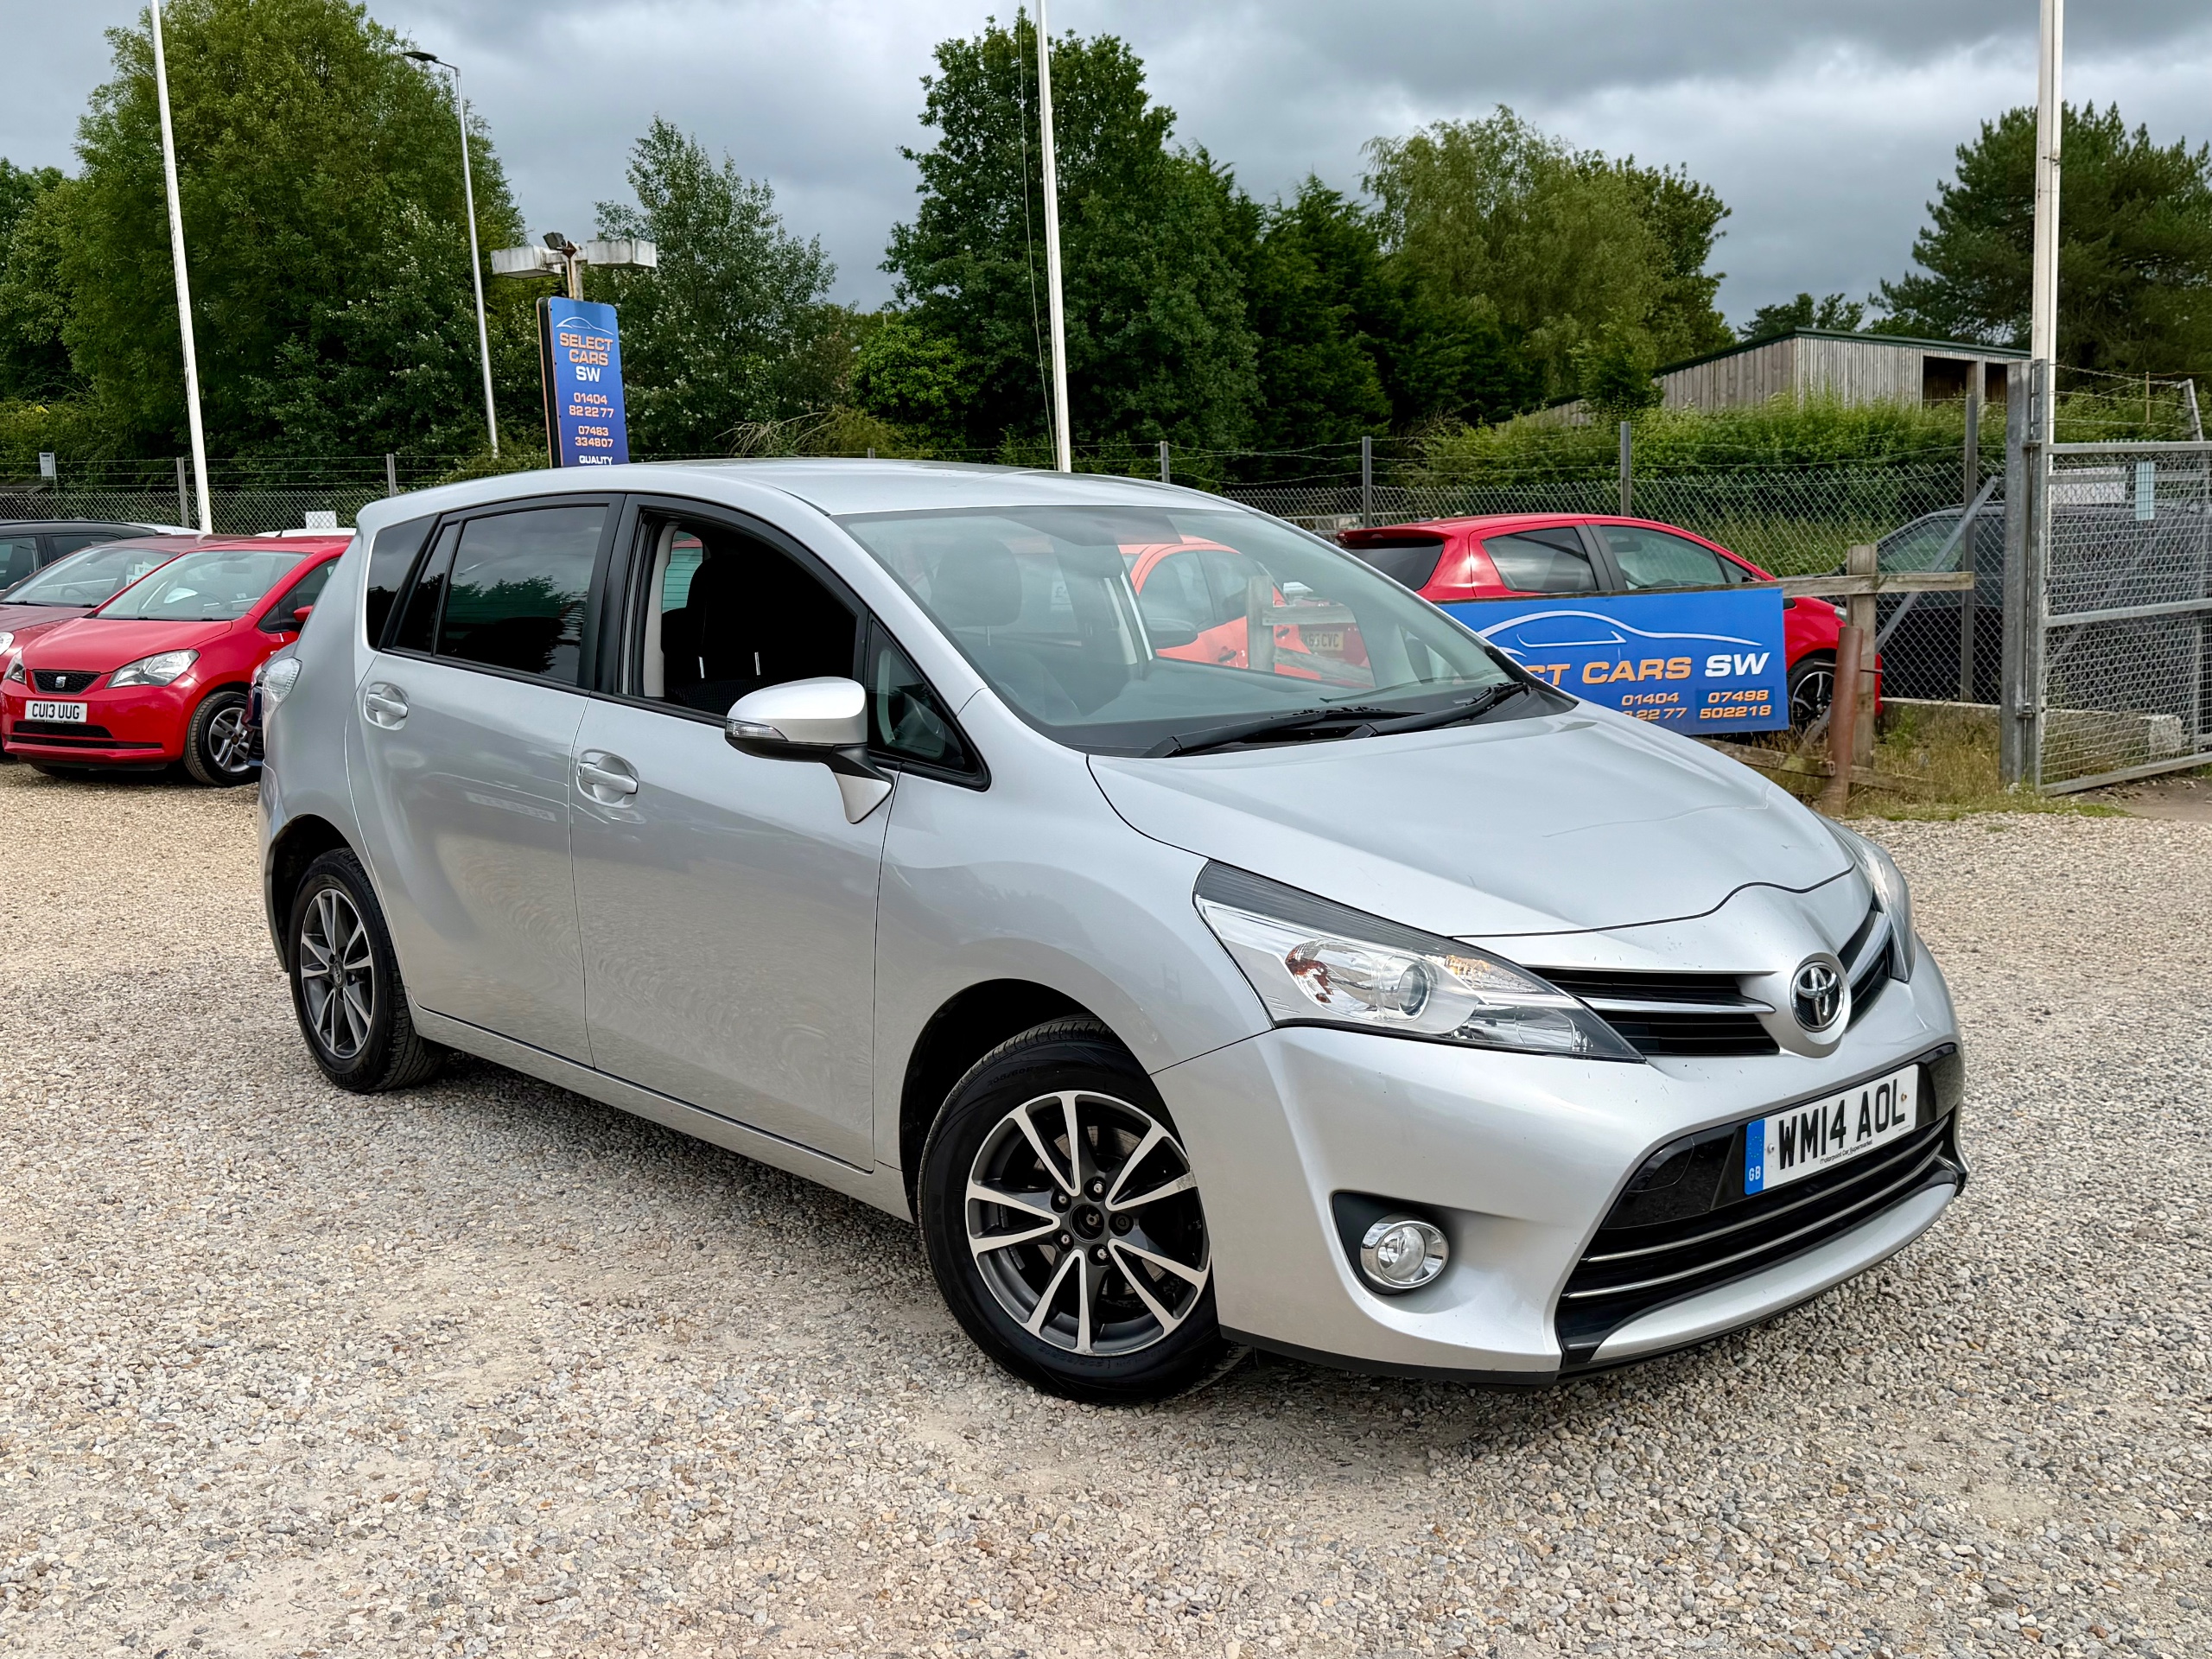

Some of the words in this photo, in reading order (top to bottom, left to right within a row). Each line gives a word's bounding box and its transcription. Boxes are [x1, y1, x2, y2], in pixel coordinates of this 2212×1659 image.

[559, 332, 613, 352] SELECT
[569, 348, 608, 366] CARS
[575, 365, 601, 383] SW
[574, 392, 607, 405] 01404
[578, 425, 608, 435] 07483
[575, 436, 613, 448] 334807
[578, 454, 613, 466] QUALITY
[1582, 658, 1692, 683] CARS
[1704, 652, 1770, 677] SW
[1621, 692, 1679, 706] 01404
[1707, 690, 1770, 704] 07498
[58, 704, 79, 720] UUG
[1699, 704, 1771, 719] 502218
[1778, 1098, 1847, 1170] WM14
[1856, 1078, 1905, 1142] AOL
[1749, 1166, 1761, 1182] GB
